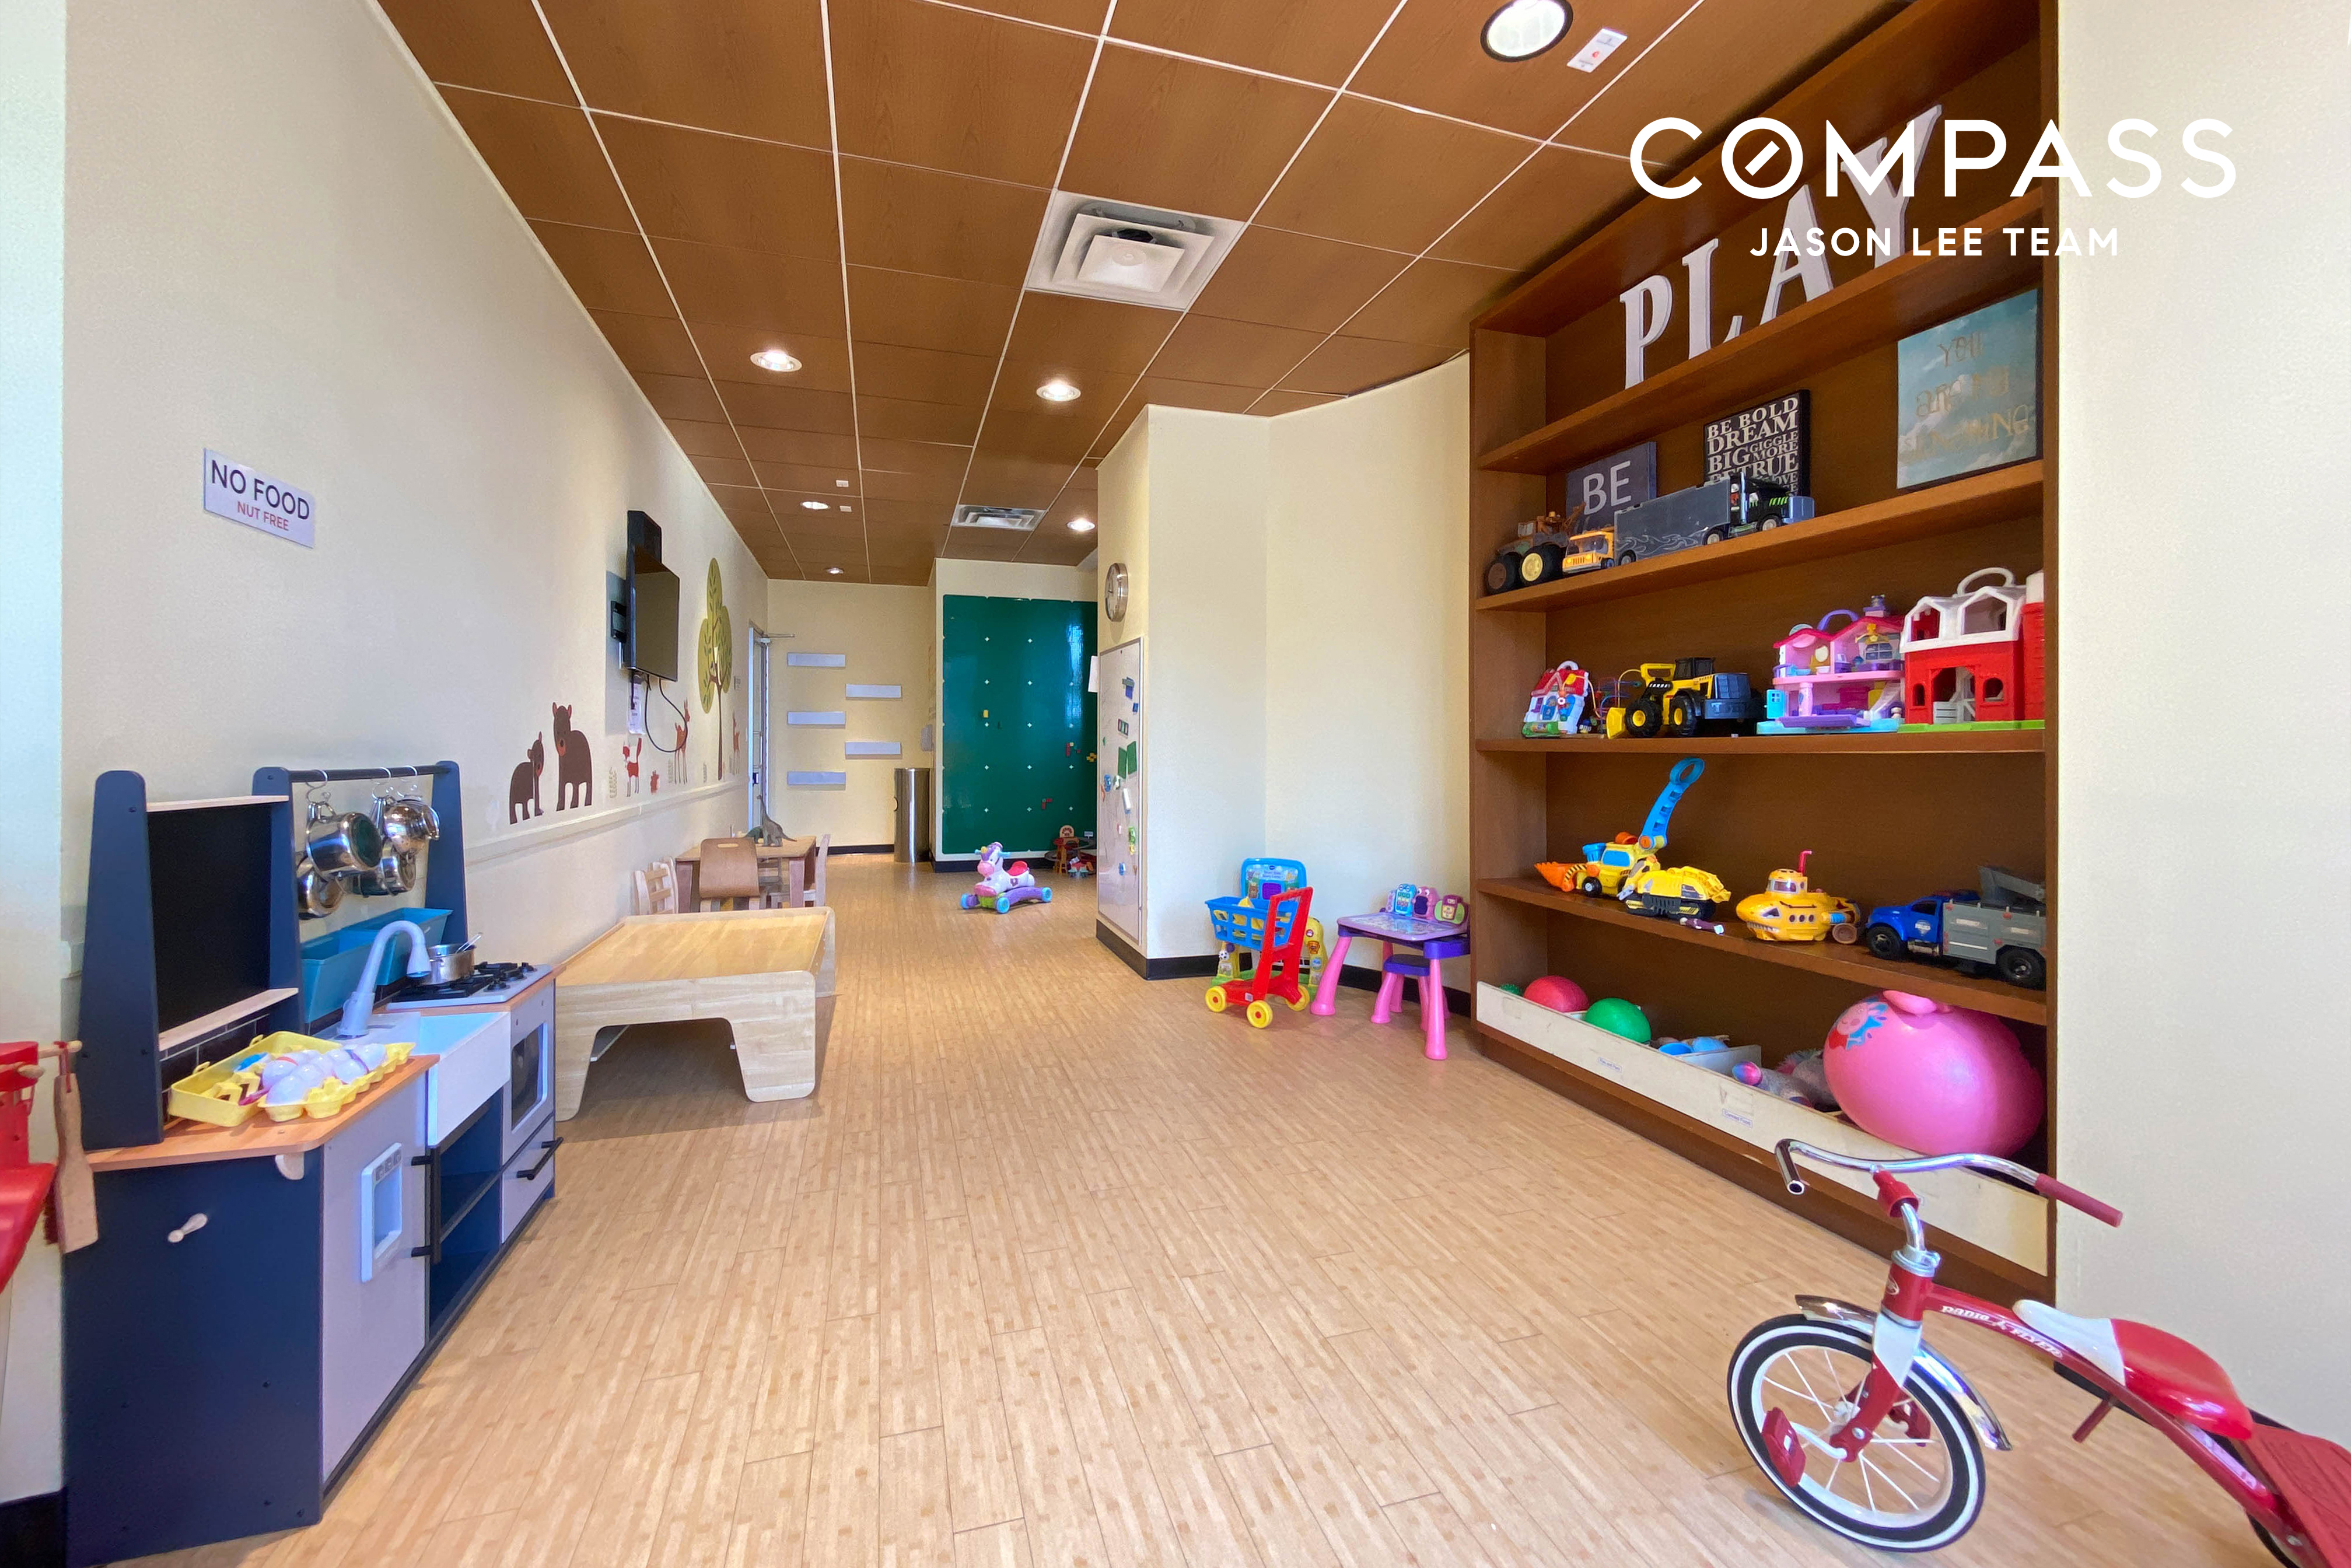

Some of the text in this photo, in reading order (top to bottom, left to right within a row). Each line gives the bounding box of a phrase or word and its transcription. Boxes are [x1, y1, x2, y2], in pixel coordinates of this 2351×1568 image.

[1619, 104, 1943, 390] PLAY
[1708, 397, 1798, 439] BE BOLD
[1708, 410, 1798, 456] DREAM
[1750, 430, 1799, 453] GIGGLE
[1752, 440, 1799, 461] MORE
[1708, 446, 1751, 474] BIG
[1737, 450, 1799, 478] TRUE
[212, 460, 309, 520] NO FOOD
[1583, 460, 1632, 515] BE
[237, 501, 289, 531] NUT FREE
[2010, 1329, 2063, 1359] FLYER
